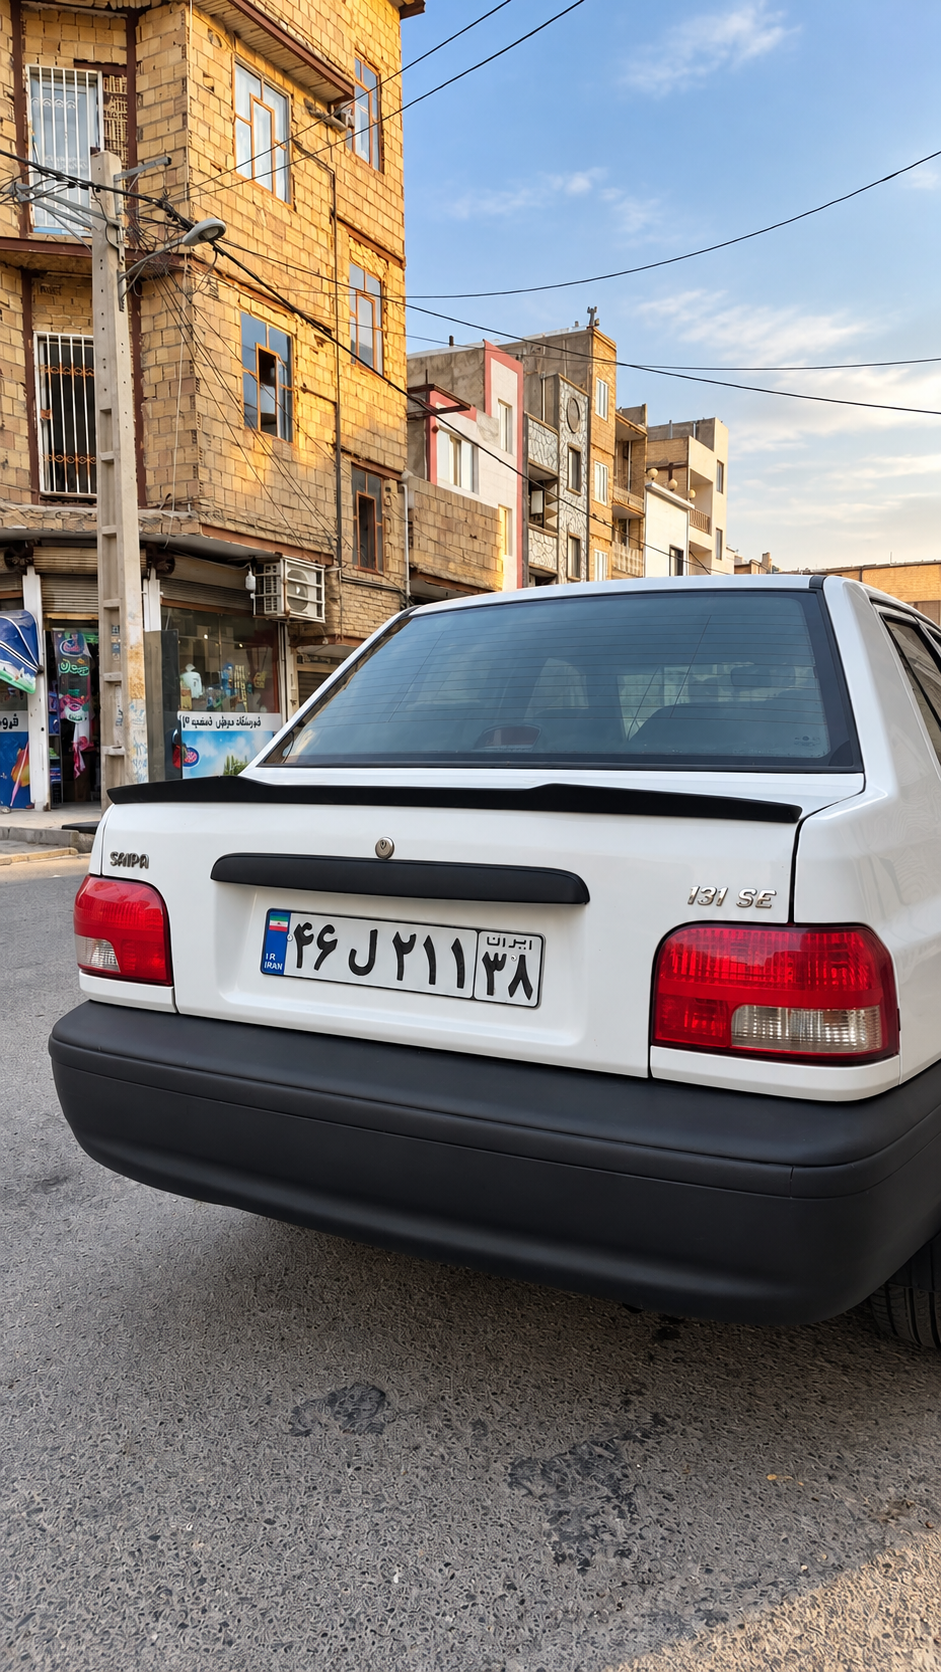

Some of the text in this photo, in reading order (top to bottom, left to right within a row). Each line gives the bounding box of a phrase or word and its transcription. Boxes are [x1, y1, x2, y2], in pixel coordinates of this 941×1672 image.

[110, 851, 149, 869] SAIPA
[687, 885, 777, 909] 131 SE
[487, 936, 532, 950] ایران
[265, 953, 276, 961] IR
[264, 961, 283, 970] IRAN
[481, 951, 533, 1000] ۳۸
